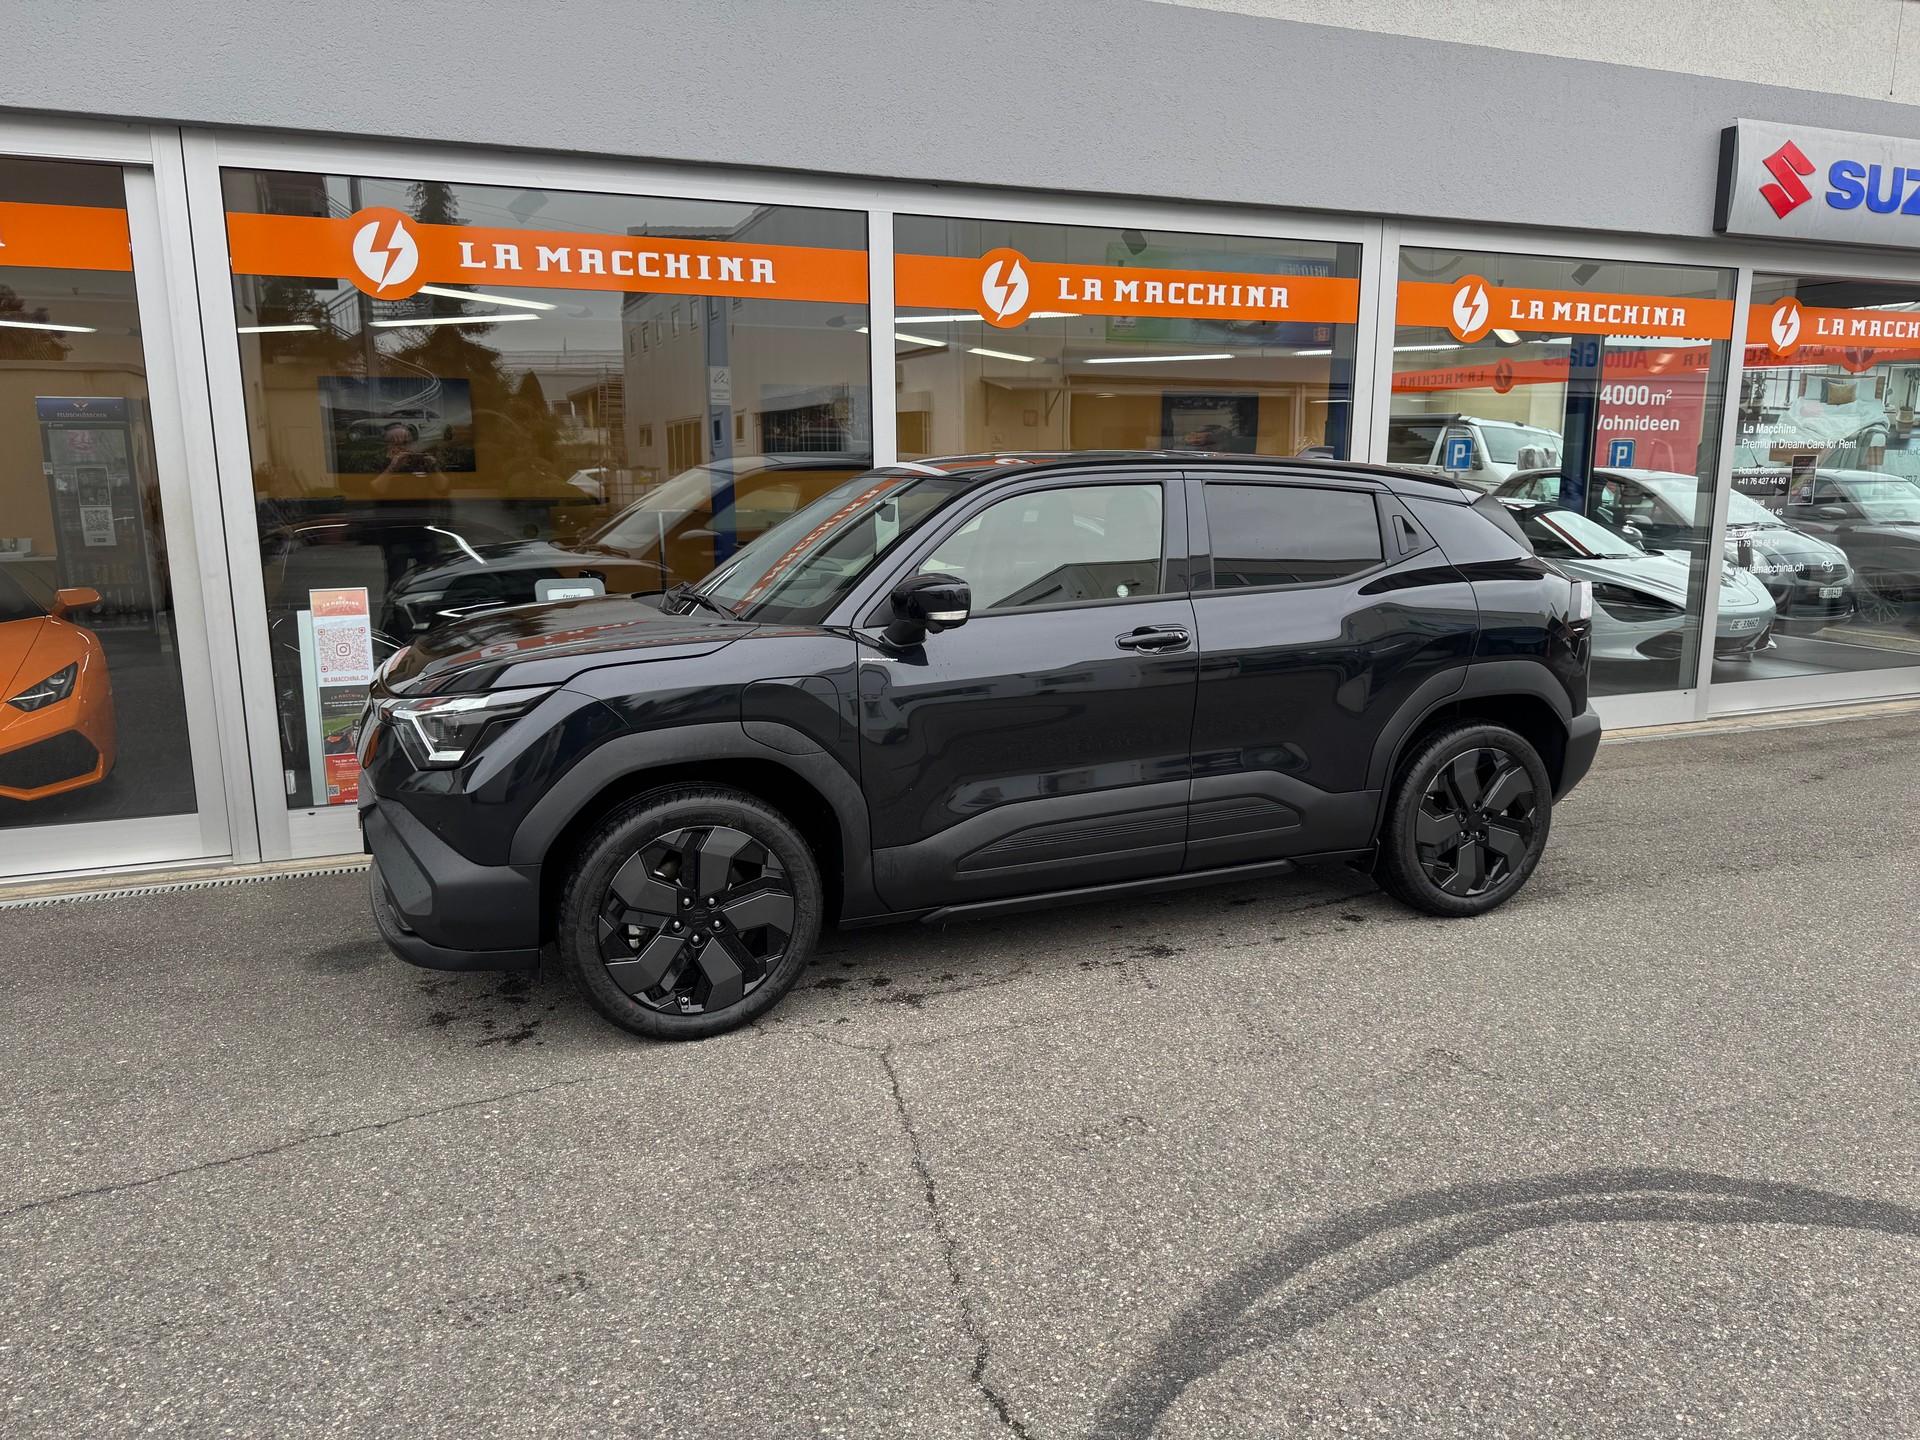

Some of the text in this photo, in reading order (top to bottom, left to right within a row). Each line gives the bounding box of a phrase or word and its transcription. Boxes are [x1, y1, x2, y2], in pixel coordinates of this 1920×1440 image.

[459, 241, 776, 284] LA MACCHINA
[1058, 277, 1289, 309] LA MACCHINA
[1510, 299, 1686, 327] LA MACCHINA
[1816, 317, 1920, 339] LA MACCH
[1599, 384, 1650, 406] 4000
[1743, 423, 1797, 434] La Macchina
[1741, 438, 1857, 449] Premium Dream Cars for Rent
[1453, 444, 1466, 466] P
[1615, 445, 1628, 467] P
[1750, 477, 1758, 485] 76
[1758, 477, 1769, 485] 427
[1770, 477, 1778, 485] 44
